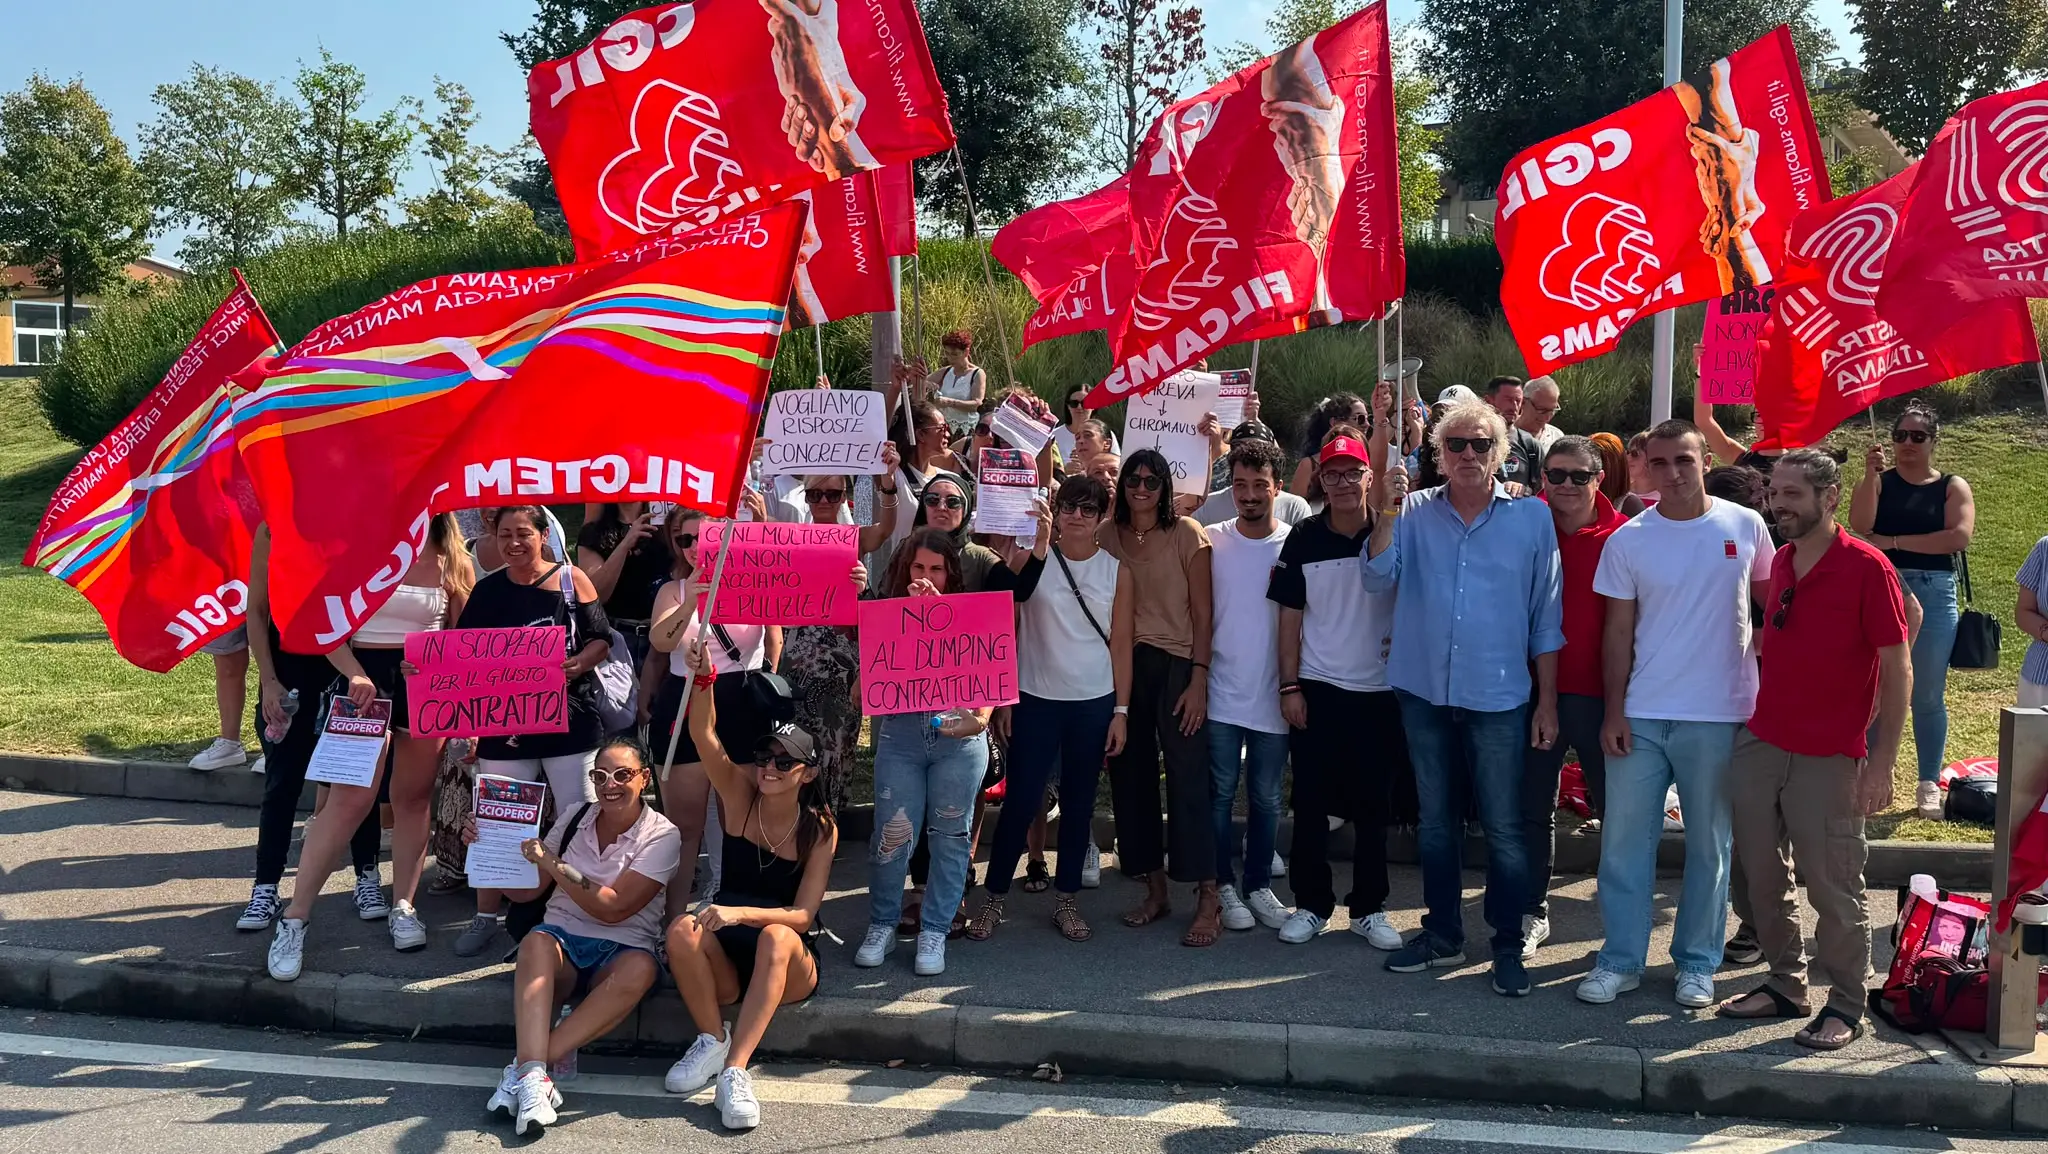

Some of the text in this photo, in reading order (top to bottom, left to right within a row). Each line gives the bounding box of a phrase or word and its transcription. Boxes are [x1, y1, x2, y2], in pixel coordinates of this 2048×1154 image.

[1715, 321, 1759, 341] NON
[1731, 379, 1752, 398] SE
[774, 392, 869, 416] VOGLIAMO
[782, 417, 864, 435] RISPOSTE
[768, 441, 882, 465] CONCRETE!
[984, 473, 1035, 485] SCIOPERO
[742, 549, 791, 568] NON
[901, 602, 953, 635] NO
[422, 627, 559, 665] IN SCIOPERO
[869, 632, 1010, 673] AL DUMPING
[429, 667, 547, 691] PER IL GIUSTO
[867, 672, 1010, 710] CONTRATTUALE
[417, 683, 566, 735] CONTRATTO!
[330, 721, 382, 734] SCIOPERO
[479, 804, 535, 821] SCIOPERO
